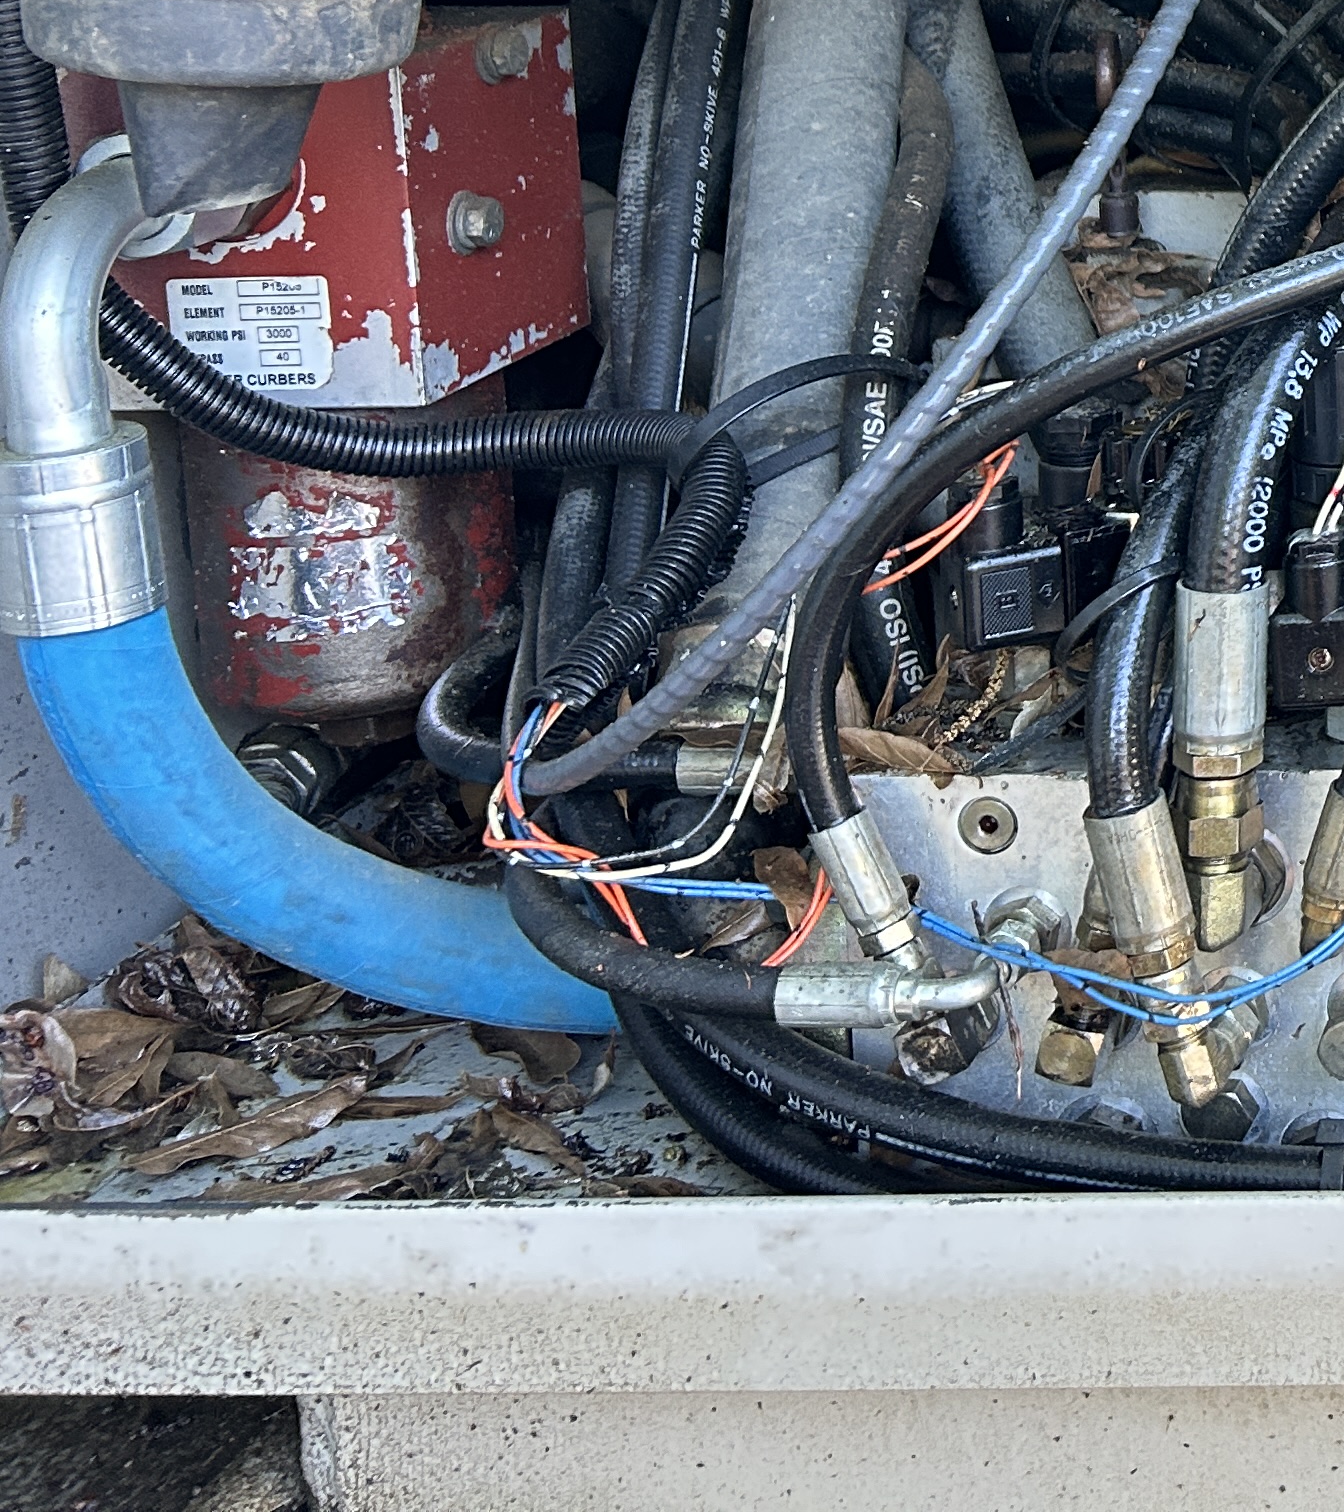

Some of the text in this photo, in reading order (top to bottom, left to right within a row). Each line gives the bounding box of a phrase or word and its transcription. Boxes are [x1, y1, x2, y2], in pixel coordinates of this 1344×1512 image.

[697, 84, 720, 172] NO-SKIVE
[690, 179, 708, 251] PARKER
[181, 284, 214, 296] MODEL
[183, 305, 307, 320] ELEMENT P15205-1
[1317, 309, 1343, 347] WP
[185, 328, 293, 343] WORKING PSI 3000
[275, 351, 290, 363] 40
[246, 373, 317, 386] CURBERS
[1260, 407, 1293, 461] MPa
[879, 596, 909, 649] ISO
[684, 1024, 872, 1139] PARKER NO-SKIVE
